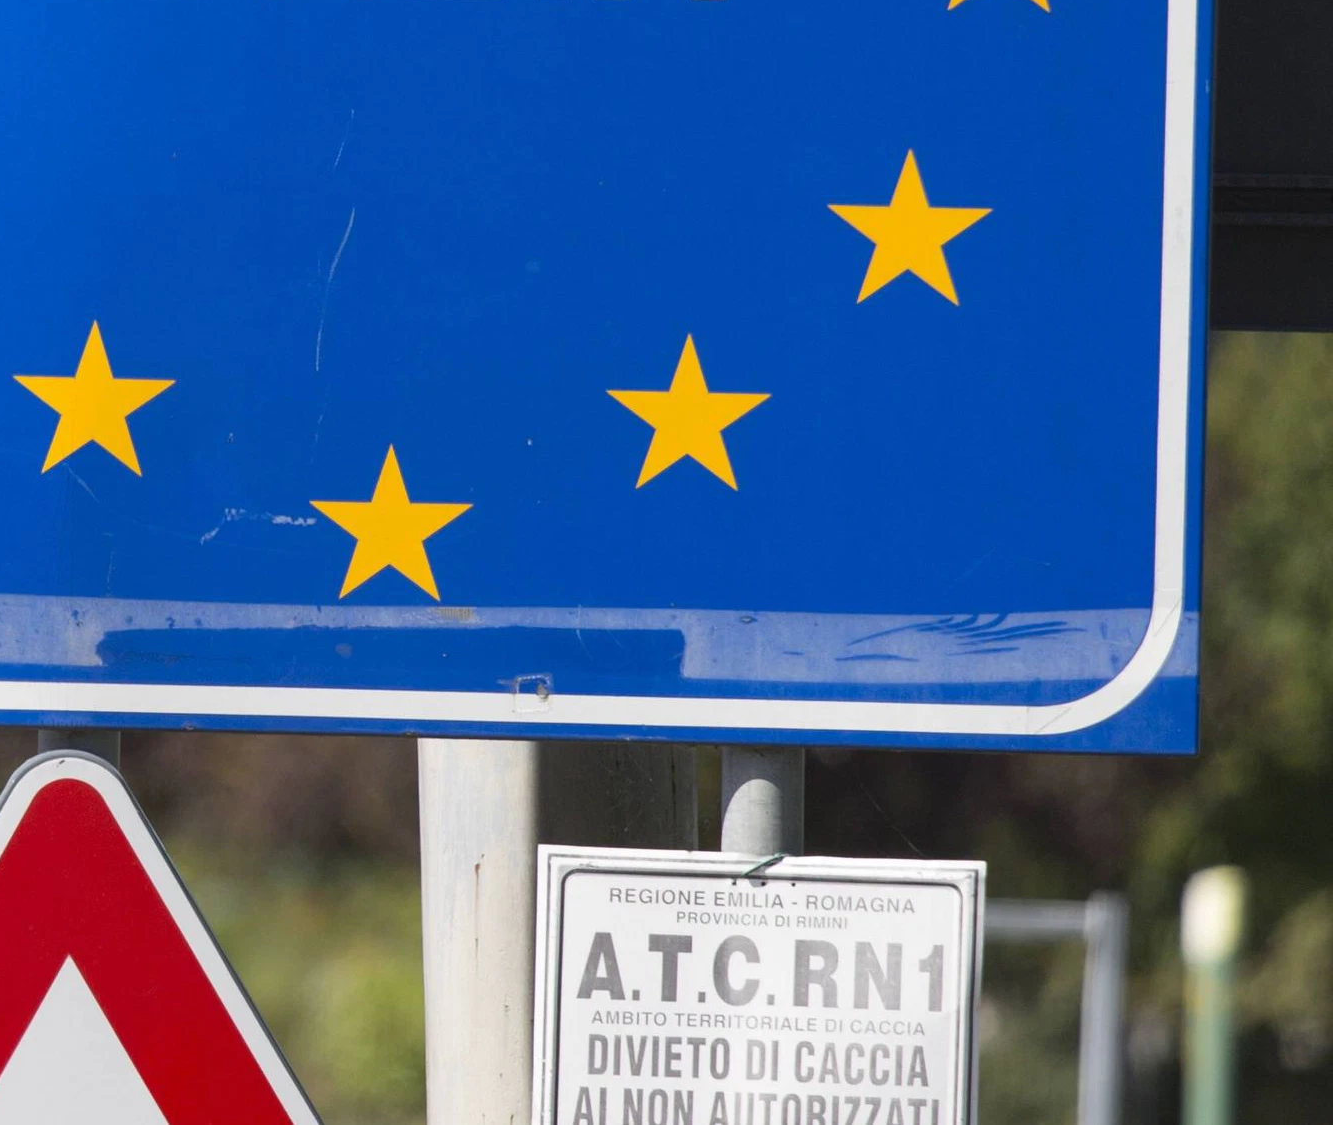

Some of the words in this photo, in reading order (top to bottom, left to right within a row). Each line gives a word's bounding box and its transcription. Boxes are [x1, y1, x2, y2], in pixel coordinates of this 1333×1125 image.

[609, 888, 706, 906] REGIONE
[714, 891, 784, 909] EMILIA
[806, 894, 916, 913] ROMAGNA
[676, 911, 769, 927] PROVINCIA
[775, 915, 791, 928] DI
[796, 916, 848, 929] RIMINI
[591, 1010, 667, 1026] AMBITO
[674, 1013, 818, 1032] TERRITORIALE
[825, 1018, 843, 1033] DI
[850, 1020, 926, 1036] CACCIA
[588, 1033, 731, 1080] DIVIETO
[745, 1038, 779, 1081] DI
[794, 1041, 929, 1087] CACCIA
[572, 1086, 607, 1125] AI
[623, 1088, 694, 1125] NON
[709, 1091, 940, 1125] AUTORIZZATI
